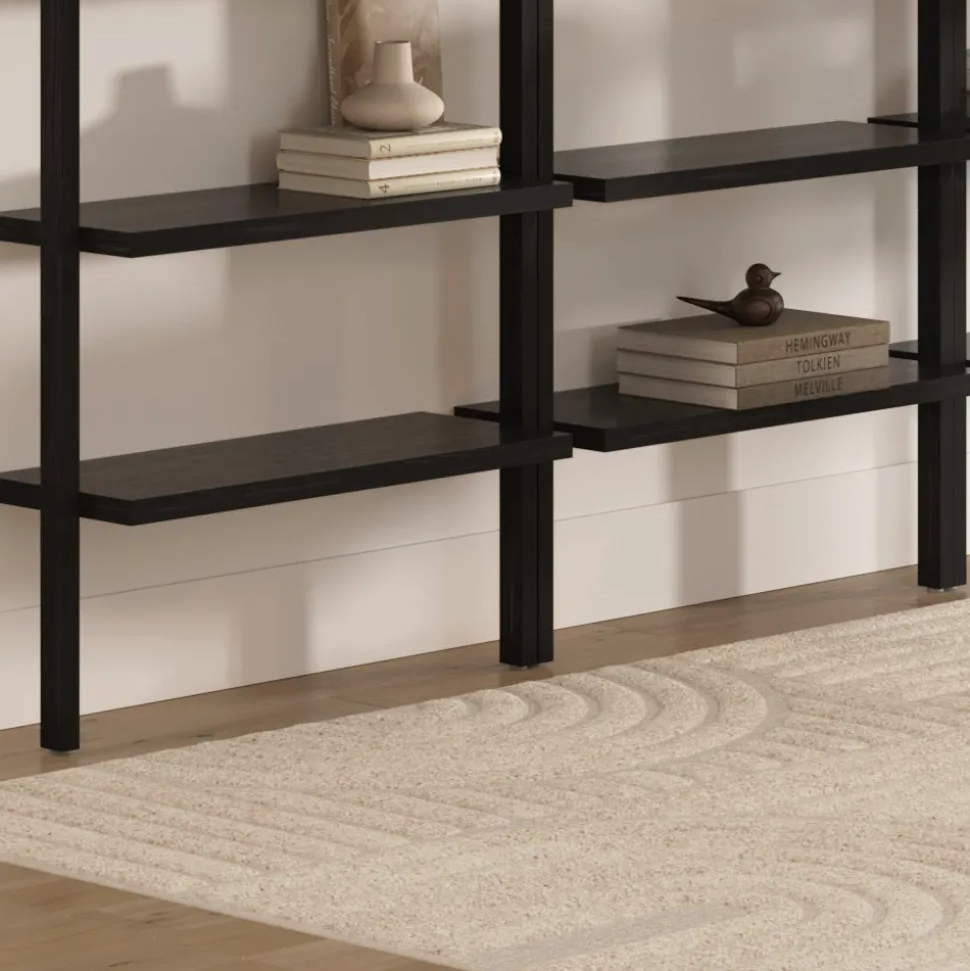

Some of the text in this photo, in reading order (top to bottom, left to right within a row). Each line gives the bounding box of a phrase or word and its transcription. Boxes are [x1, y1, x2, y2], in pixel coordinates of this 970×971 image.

[785, 332, 851, 353] HEMINGWAY
[796, 355, 840, 374] TOLKIEN
[793, 377, 844, 397] MELVILLE
